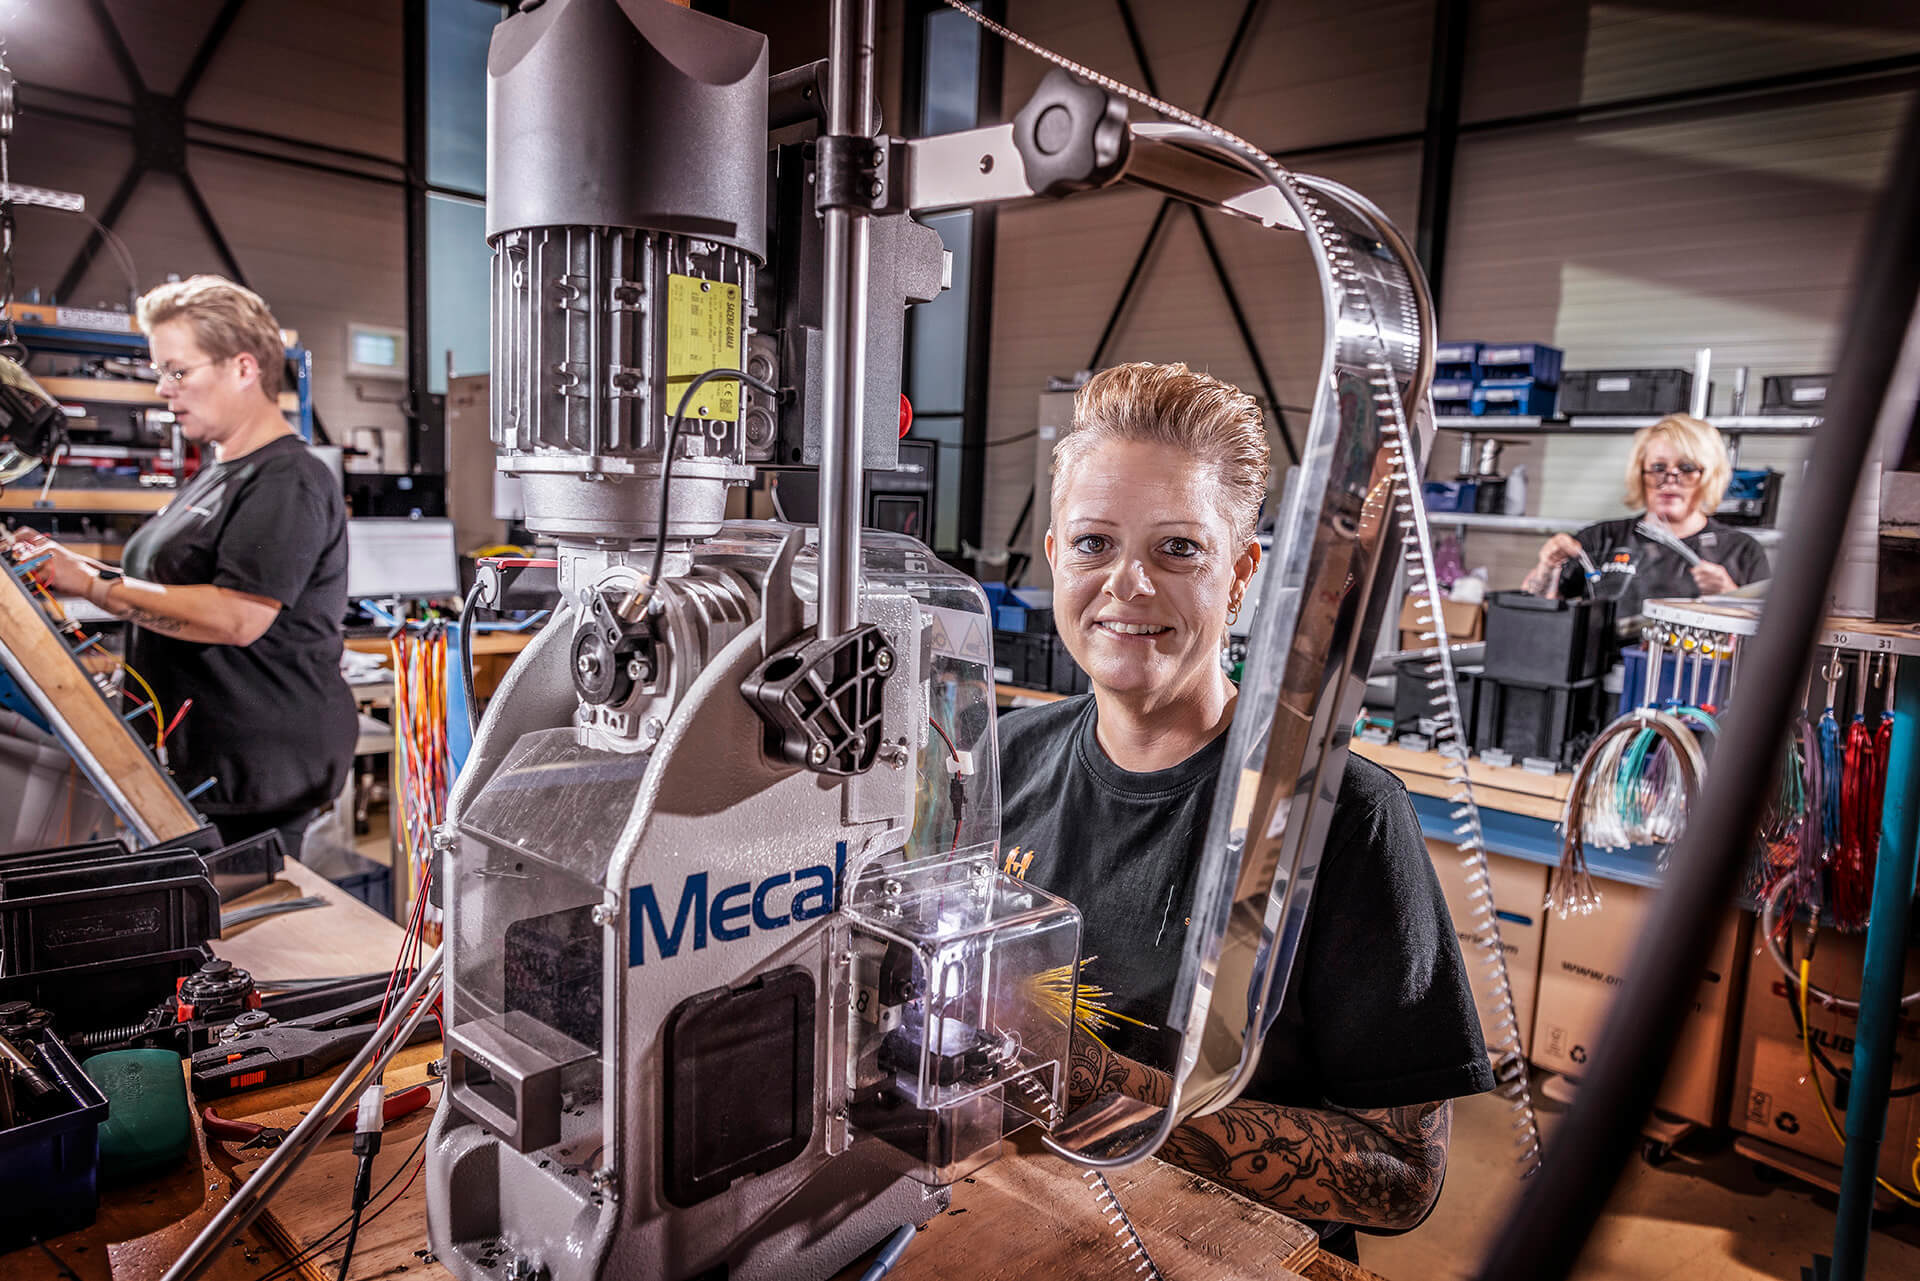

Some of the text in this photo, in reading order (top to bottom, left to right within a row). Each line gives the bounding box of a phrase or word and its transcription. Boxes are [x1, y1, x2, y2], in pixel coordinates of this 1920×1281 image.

[1833, 633, 1848, 644] 30
[1878, 639, 1892, 649] 31
[628, 840, 847, 968] Mecal
